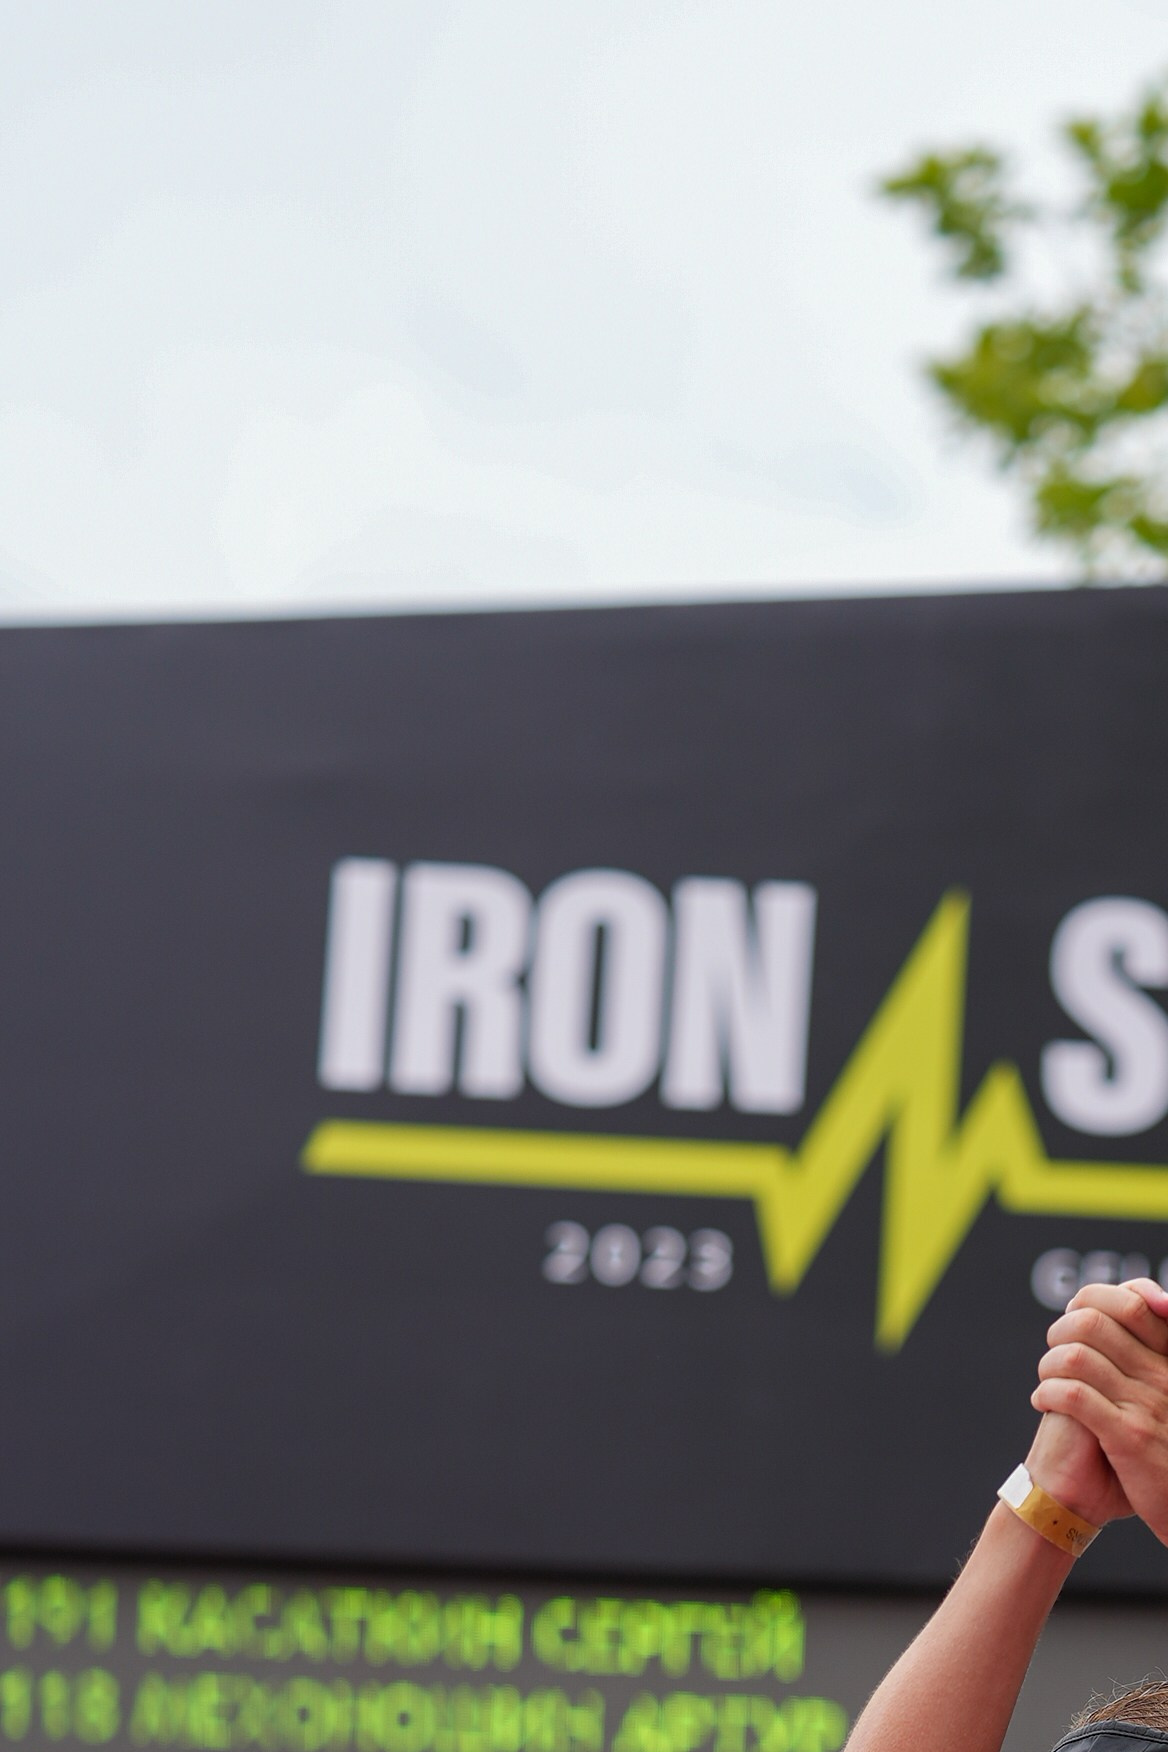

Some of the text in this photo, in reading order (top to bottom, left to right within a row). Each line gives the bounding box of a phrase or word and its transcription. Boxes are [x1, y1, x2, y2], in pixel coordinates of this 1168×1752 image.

[318, 857, 817, 1114] IRON
[543, 1220, 734, 1292] 2023
[3, 1573, 117, 1652] 191
[531, 1588, 805, 1682] СЕРГЕЙ
